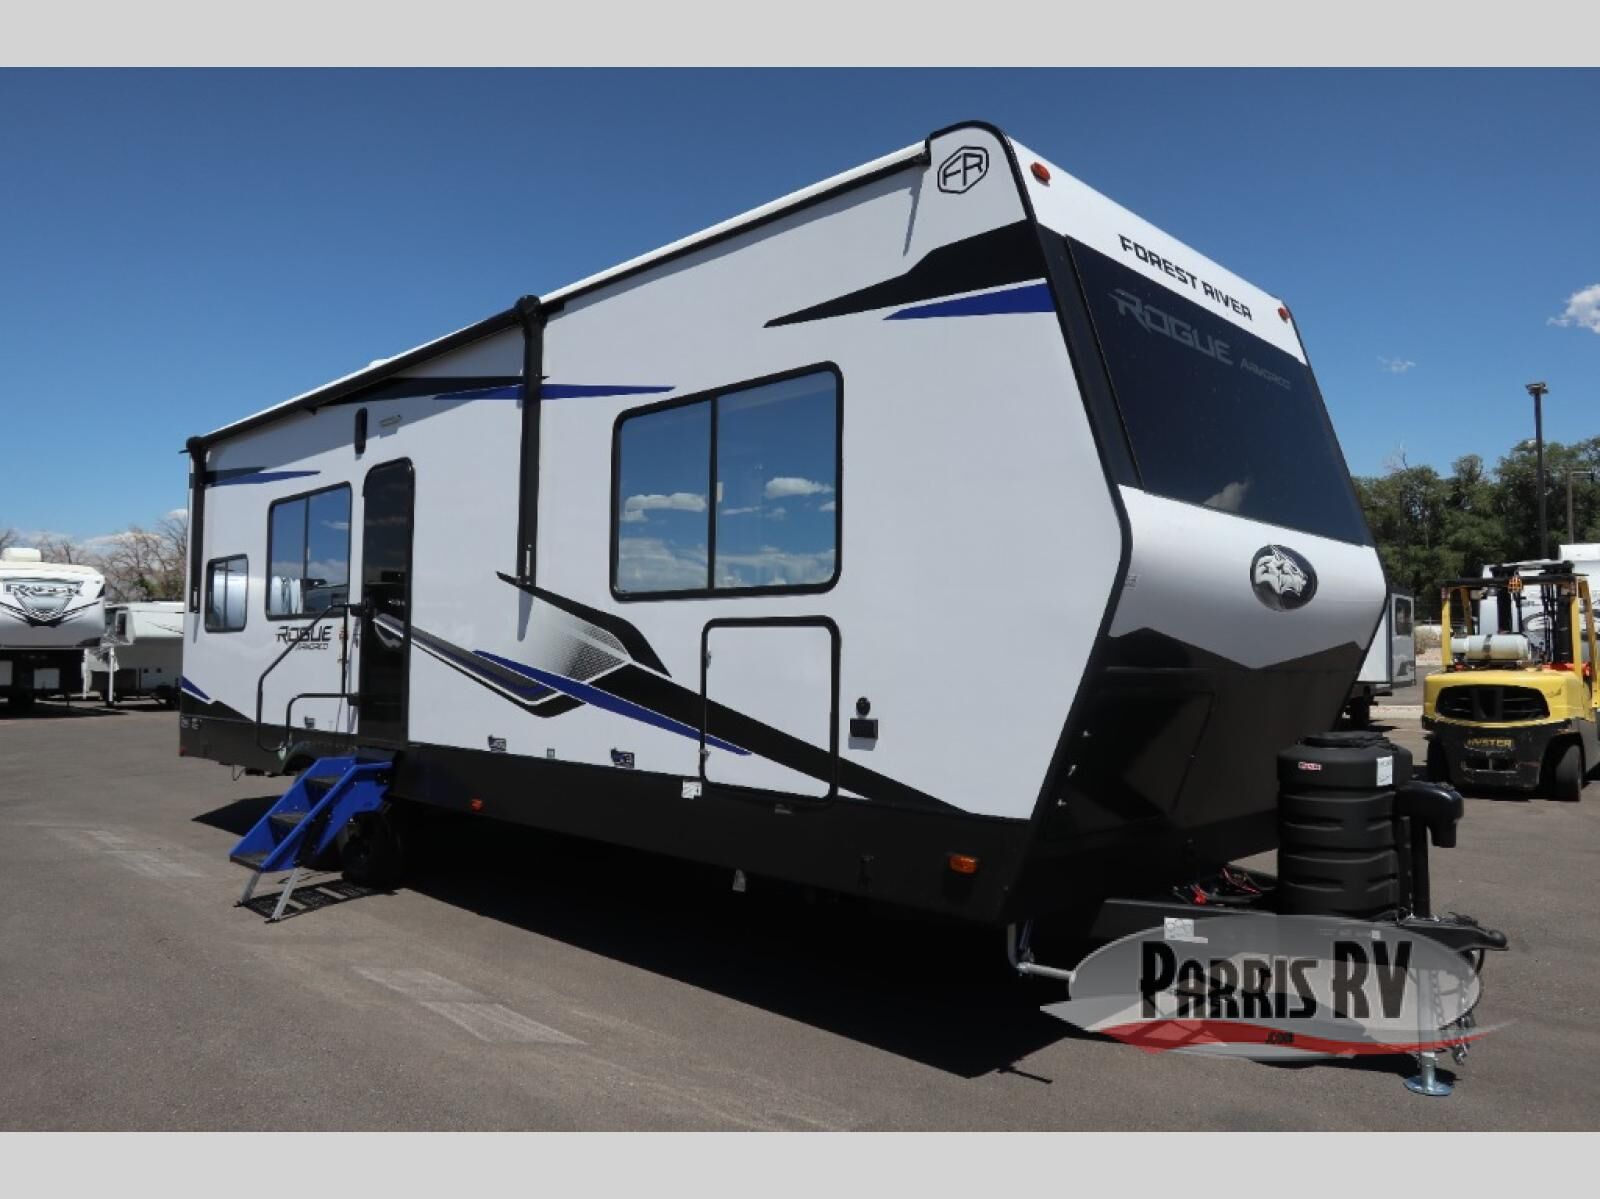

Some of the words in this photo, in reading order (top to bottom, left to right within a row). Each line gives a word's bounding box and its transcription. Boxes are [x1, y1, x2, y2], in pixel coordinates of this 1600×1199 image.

[1117, 233, 1198, 290] FOREST
[1200, 279, 1254, 321] RIVER
[1108, 288, 1234, 366] ROGUE
[275, 625, 334, 645] ROGUE
